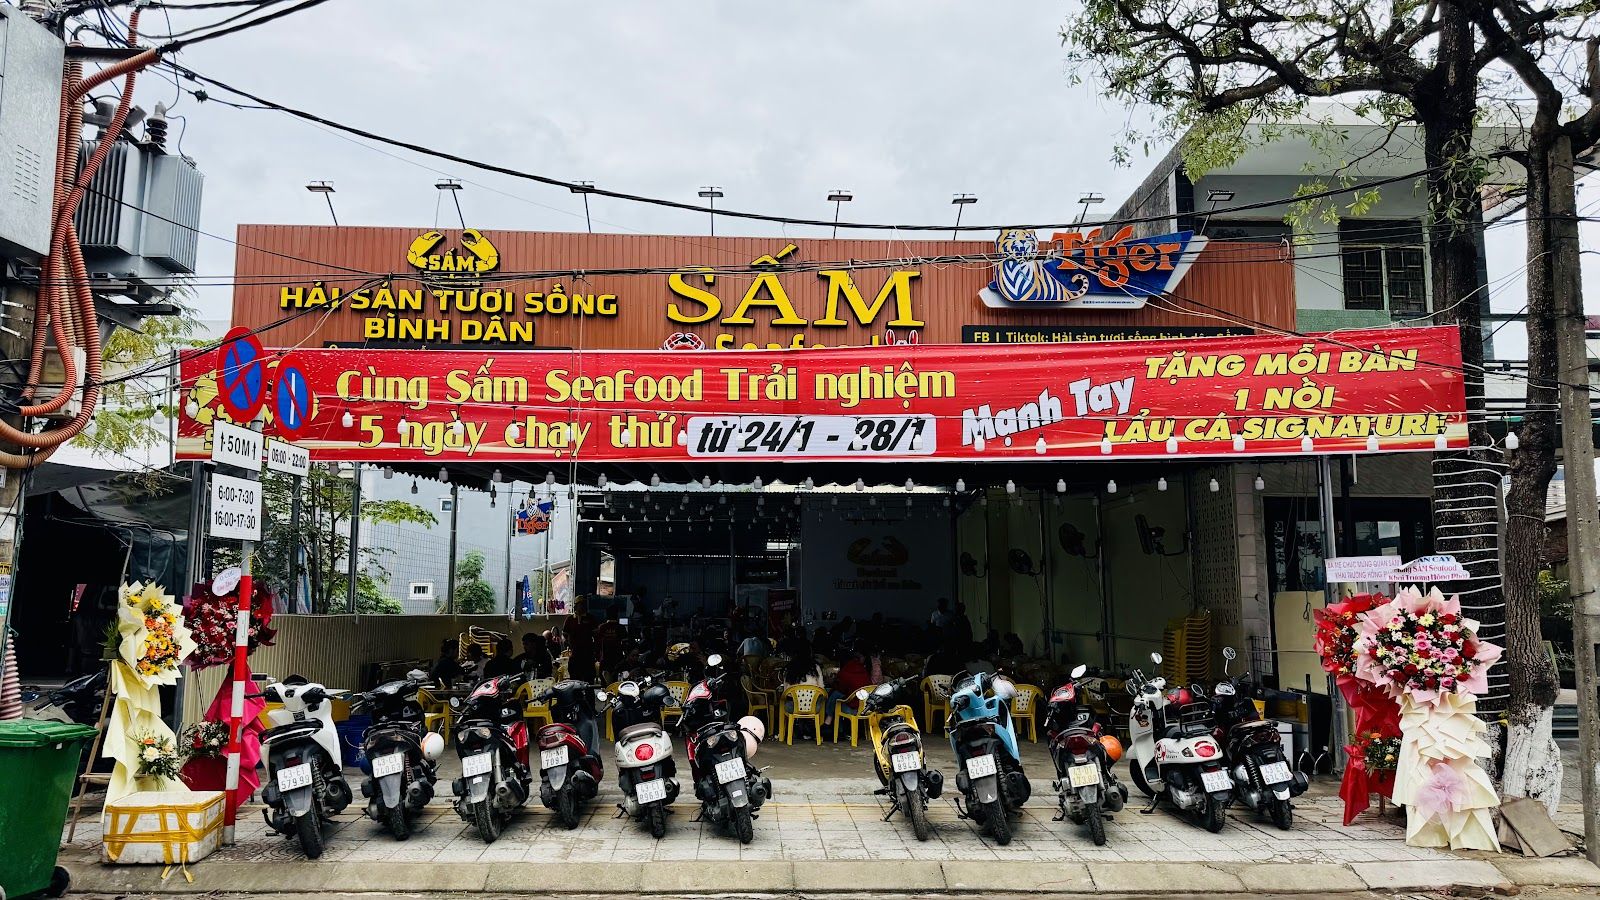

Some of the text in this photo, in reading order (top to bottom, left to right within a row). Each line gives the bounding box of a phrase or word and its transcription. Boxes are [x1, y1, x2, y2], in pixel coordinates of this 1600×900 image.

[428, 248, 475, 272] SẤM
[1052, 225, 1181, 287] Tiger
[350, 281, 422, 310] SẢN
[433, 287, 513, 313] TƯƠI
[524, 283, 617, 315] SỐNG
[667, 243, 925, 327] SẤM
[364, 312, 533, 342] BÌNH DÂN
[974, 331, 990, 343] FB
[1006, 331, 1049, 343] Tiktok:
[1145, 350, 1247, 385] TẶNG
[1338, 344, 1418, 374] BÀN
[336, 366, 430, 410] Cùng
[445, 358, 528, 403] Sấm
[720, 363, 798, 402] Trải
[815, 361, 955, 410] nghiệm
[1234, 376, 1335, 411] 1 NỒI
[962, 376, 1135, 447] Mạnh Tay
[1184, 411, 1232, 441] CÁ
[1242, 413, 1447, 440] SIGNATURE
[227, 435, 250, 457] 50M
[359, 415, 384, 448] 5
[400, 410, 487, 458] ngày
[504, 415, 591, 458] chạy
[699, 420, 737, 453] từ
[737, 420, 816, 453] 24/1
[848, 419, 926, 452] 28/1
[218, 485, 254, 505] 6:00-7:30
[214, 510, 256, 530] 16:00-17:30
